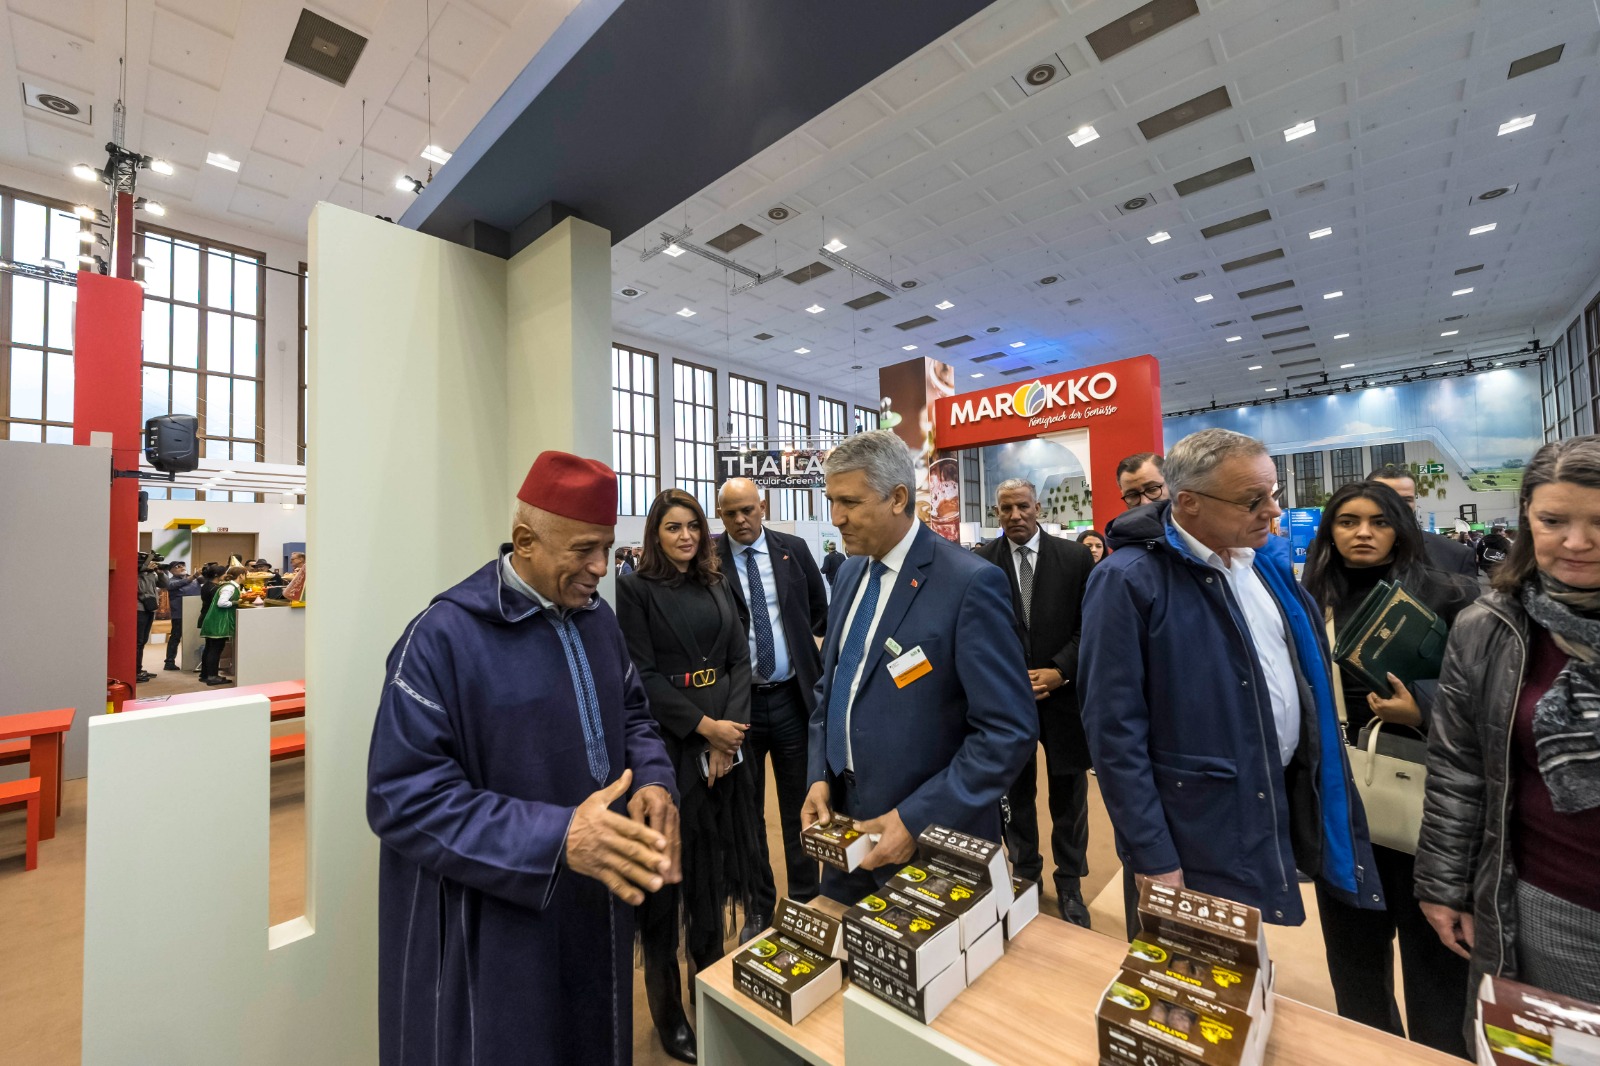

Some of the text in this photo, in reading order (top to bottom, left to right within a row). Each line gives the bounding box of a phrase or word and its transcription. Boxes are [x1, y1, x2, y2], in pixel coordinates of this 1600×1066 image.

[951, 372, 1117, 426] MAROKKO
[1028, 404, 1118, 429] Königreich der Genüsse
[722, 455, 825, 476] THAILA
[1186, 994, 1227, 1015] NAJDA
[1148, 1019, 1189, 1041] DATTELN
